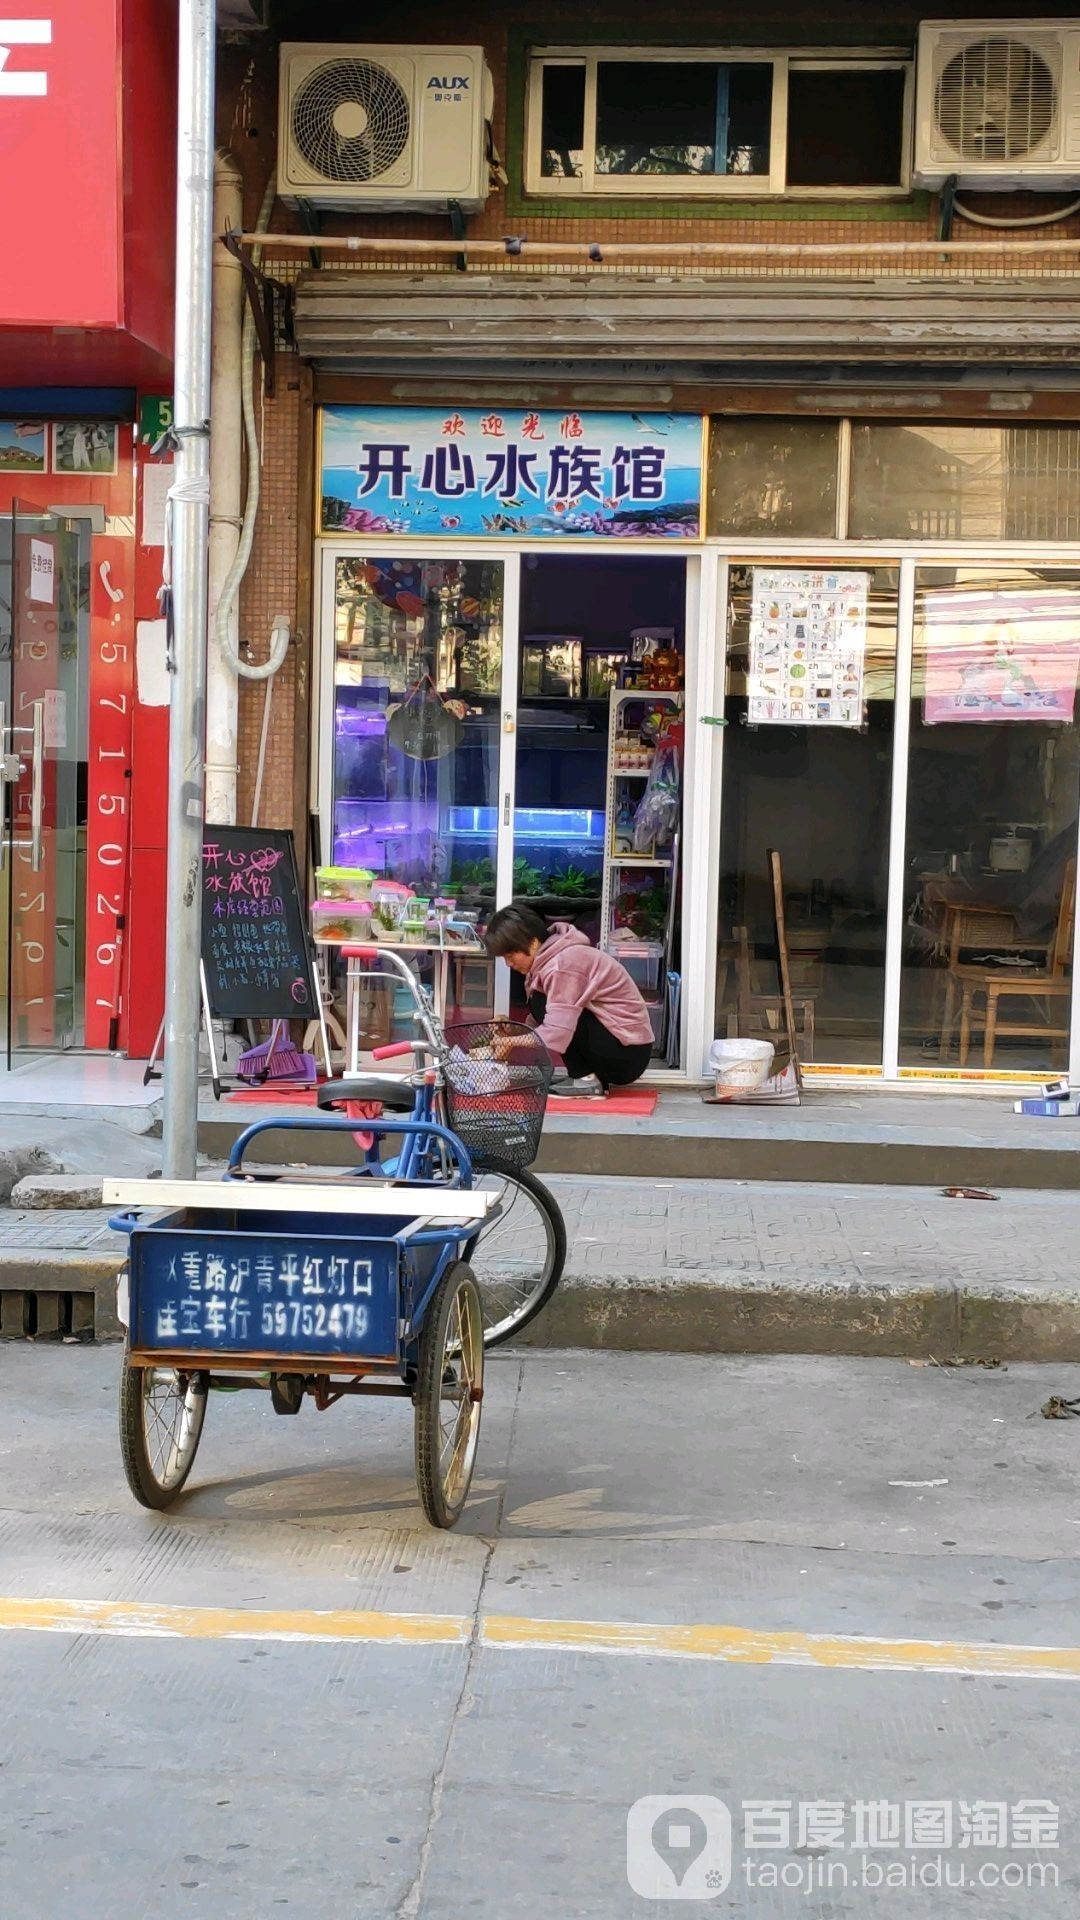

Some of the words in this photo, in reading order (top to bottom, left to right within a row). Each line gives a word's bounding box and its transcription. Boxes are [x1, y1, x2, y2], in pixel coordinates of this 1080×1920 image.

[427, 76, 470, 89] AUX
[440, 412, 583, 440] 欢迎光临
[358, 443, 666, 500] 开心水族馆
[202, 844, 247, 871] 开心
[205, 872, 272, 898] 水族馆
